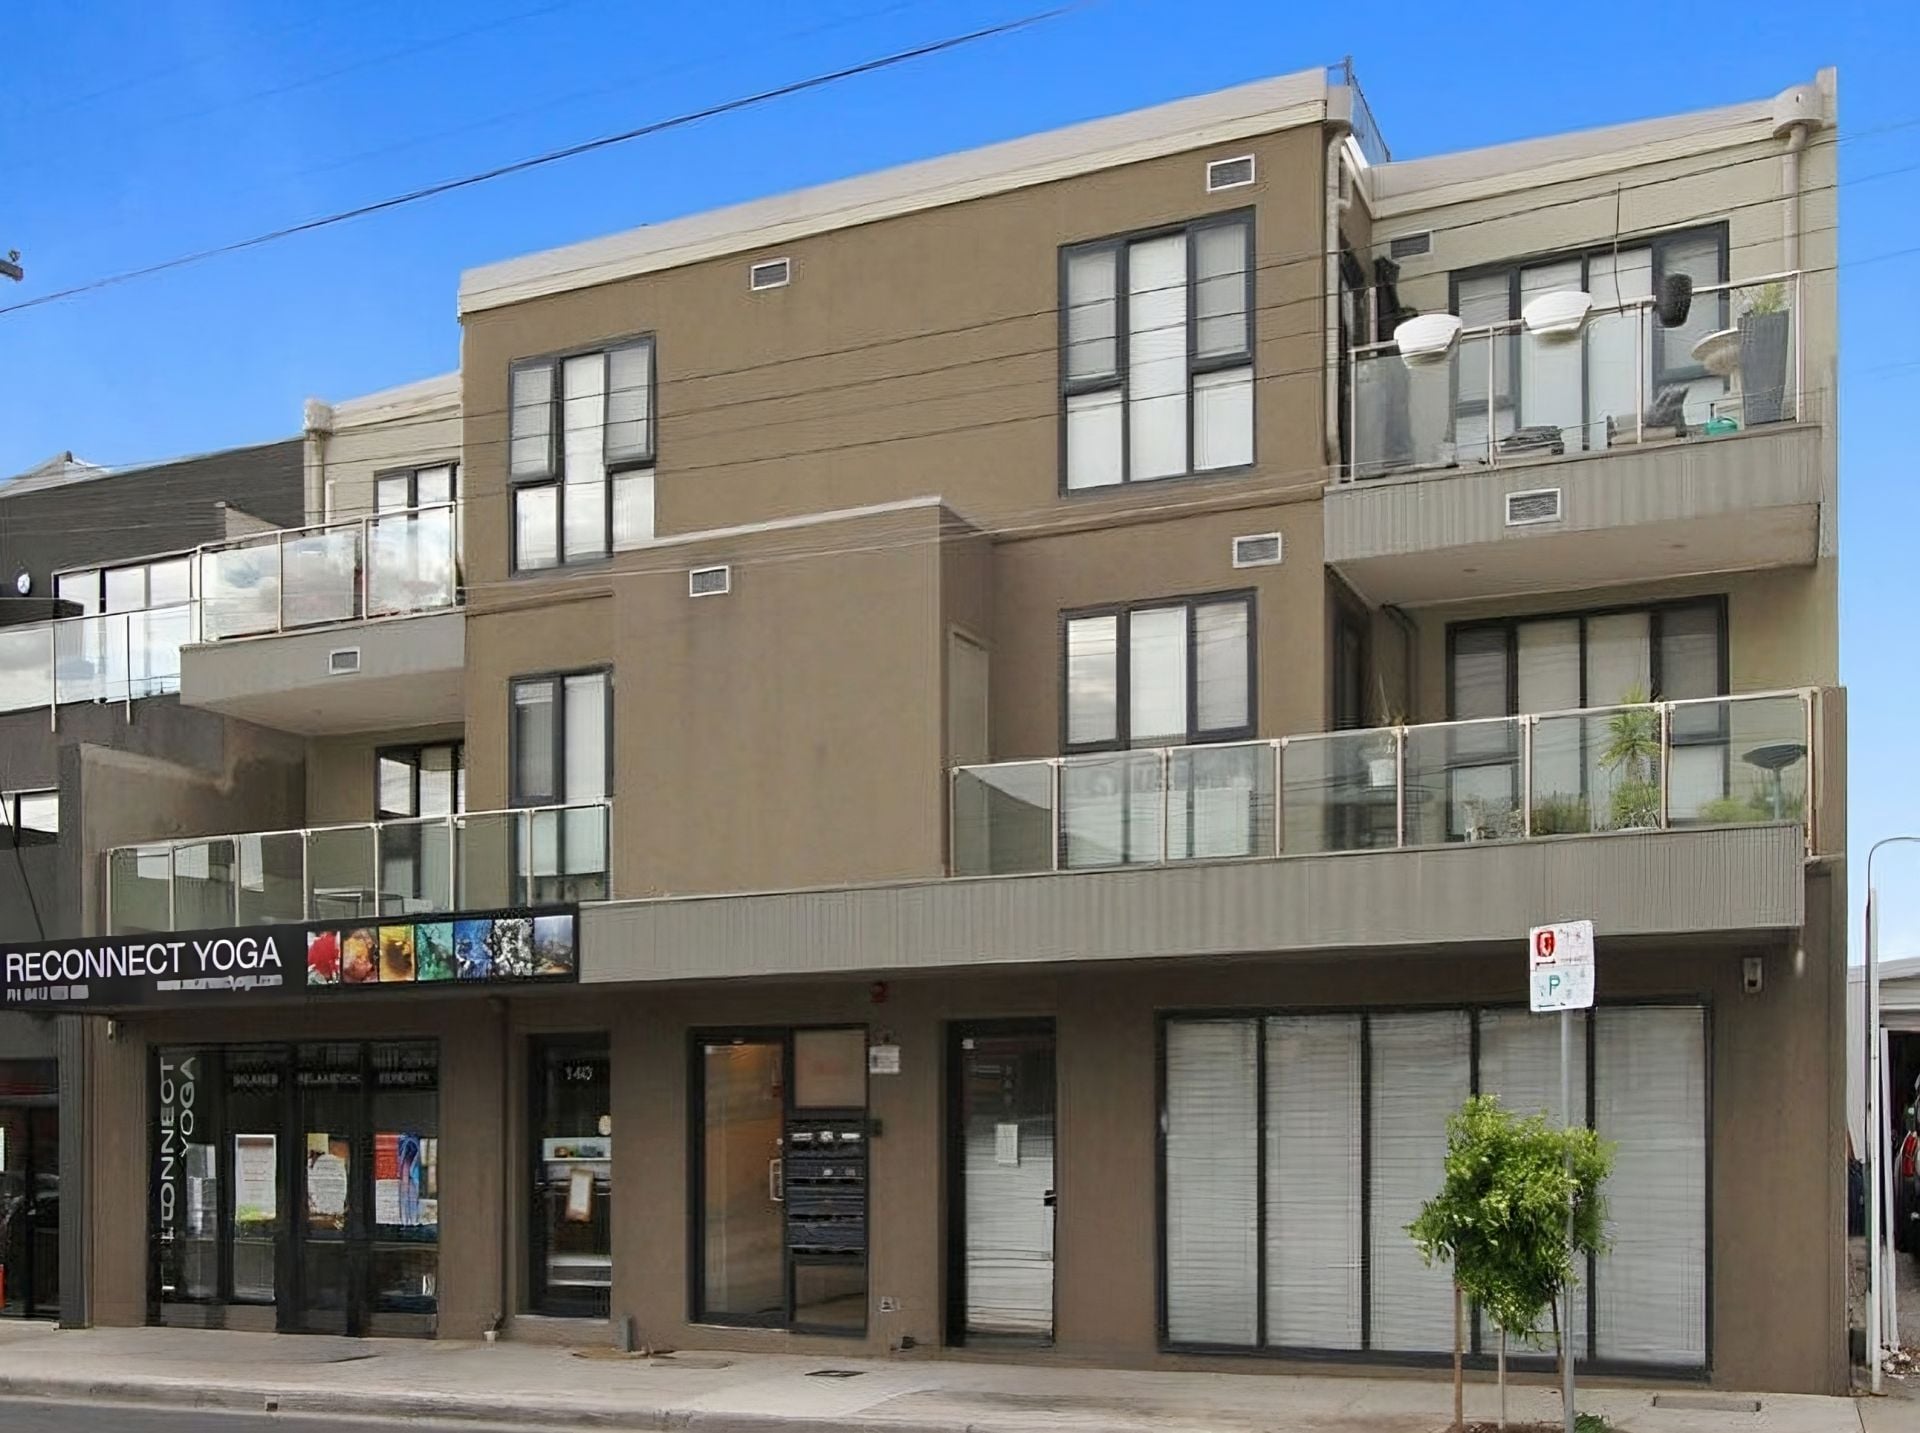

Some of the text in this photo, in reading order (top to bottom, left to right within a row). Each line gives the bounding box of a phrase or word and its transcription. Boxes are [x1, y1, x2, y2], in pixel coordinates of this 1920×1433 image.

[6, 942, 186, 983] RECONNECT
[192, 936, 282, 972] YOGA
[1548, 974, 1561, 997] P
[179, 1056, 196, 1158] YOGA
